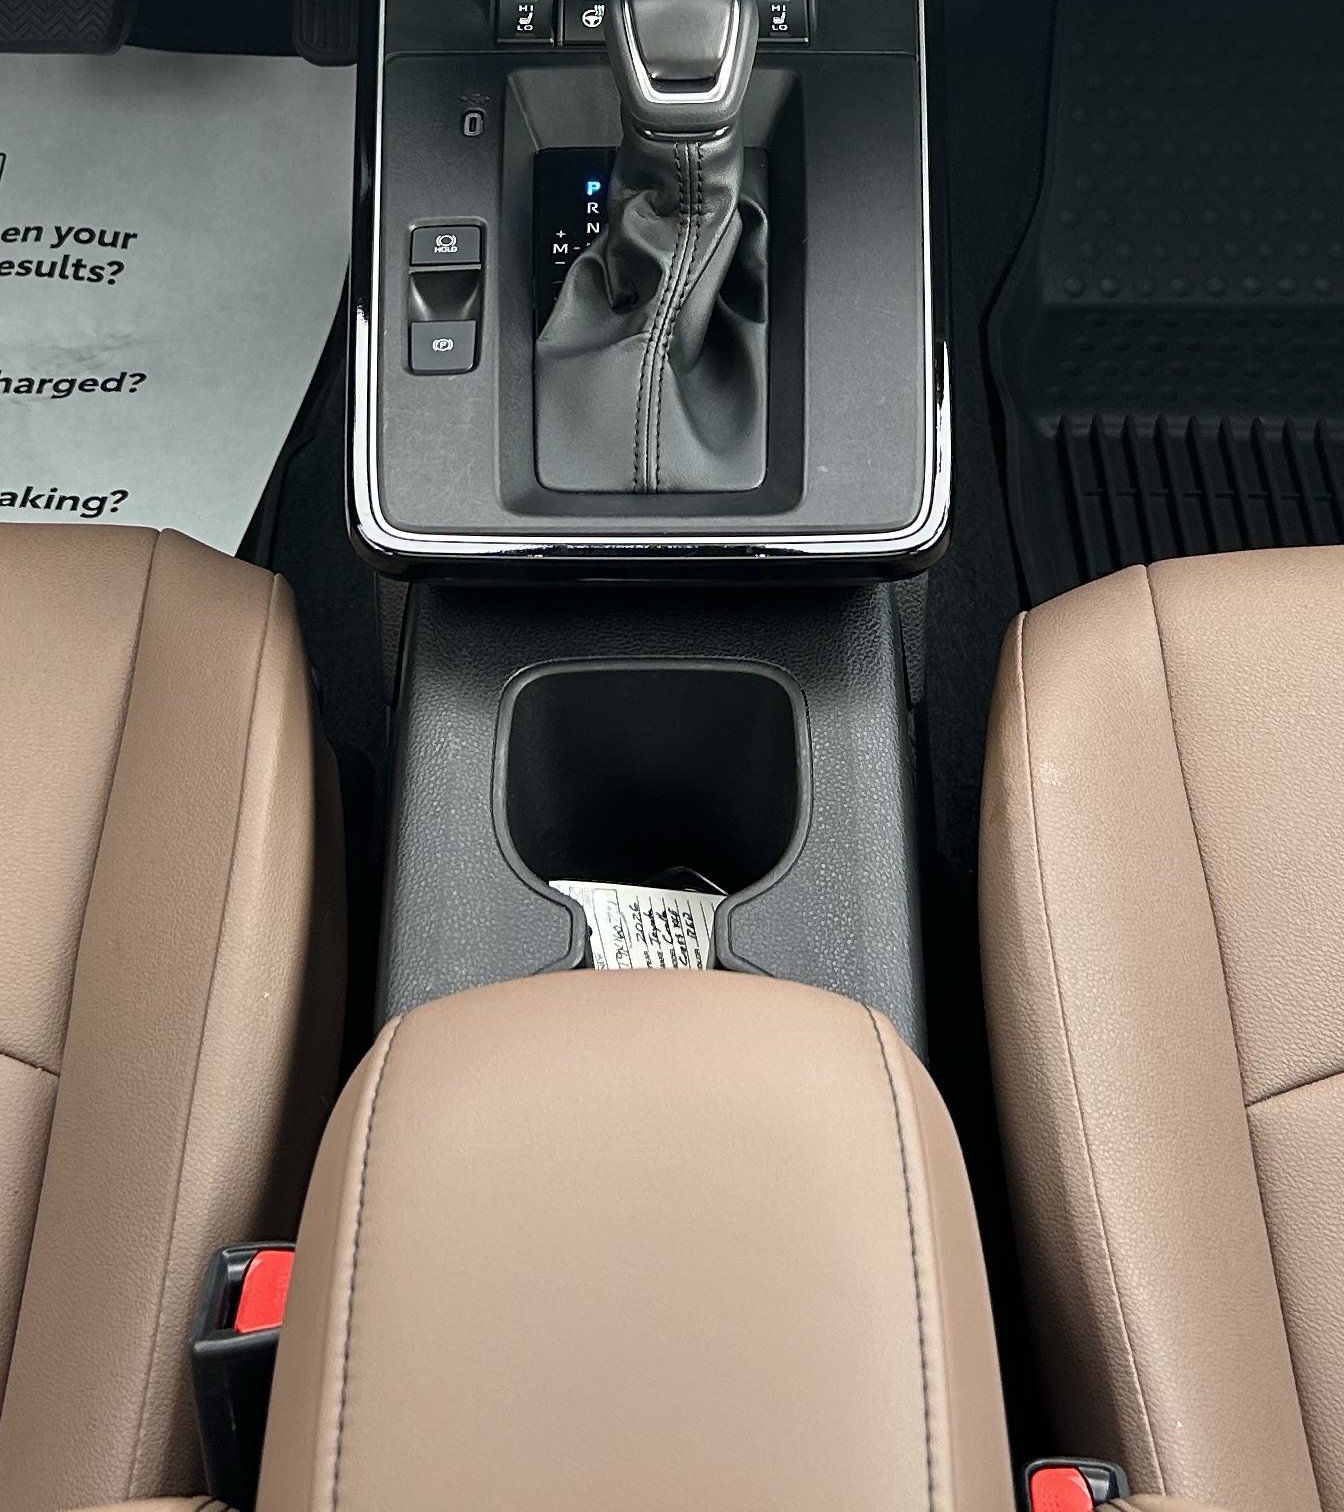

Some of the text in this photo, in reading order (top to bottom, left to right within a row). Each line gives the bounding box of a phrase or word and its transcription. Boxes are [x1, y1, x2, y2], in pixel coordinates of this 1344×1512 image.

[587, 181, 601, 196] P
[587, 201, 600, 214] R
[586, 222, 600, 234] N
[49, 225, 138, 250] your
[434, 245, 458, 254] HOLD
[552, 243, 569, 254] M
